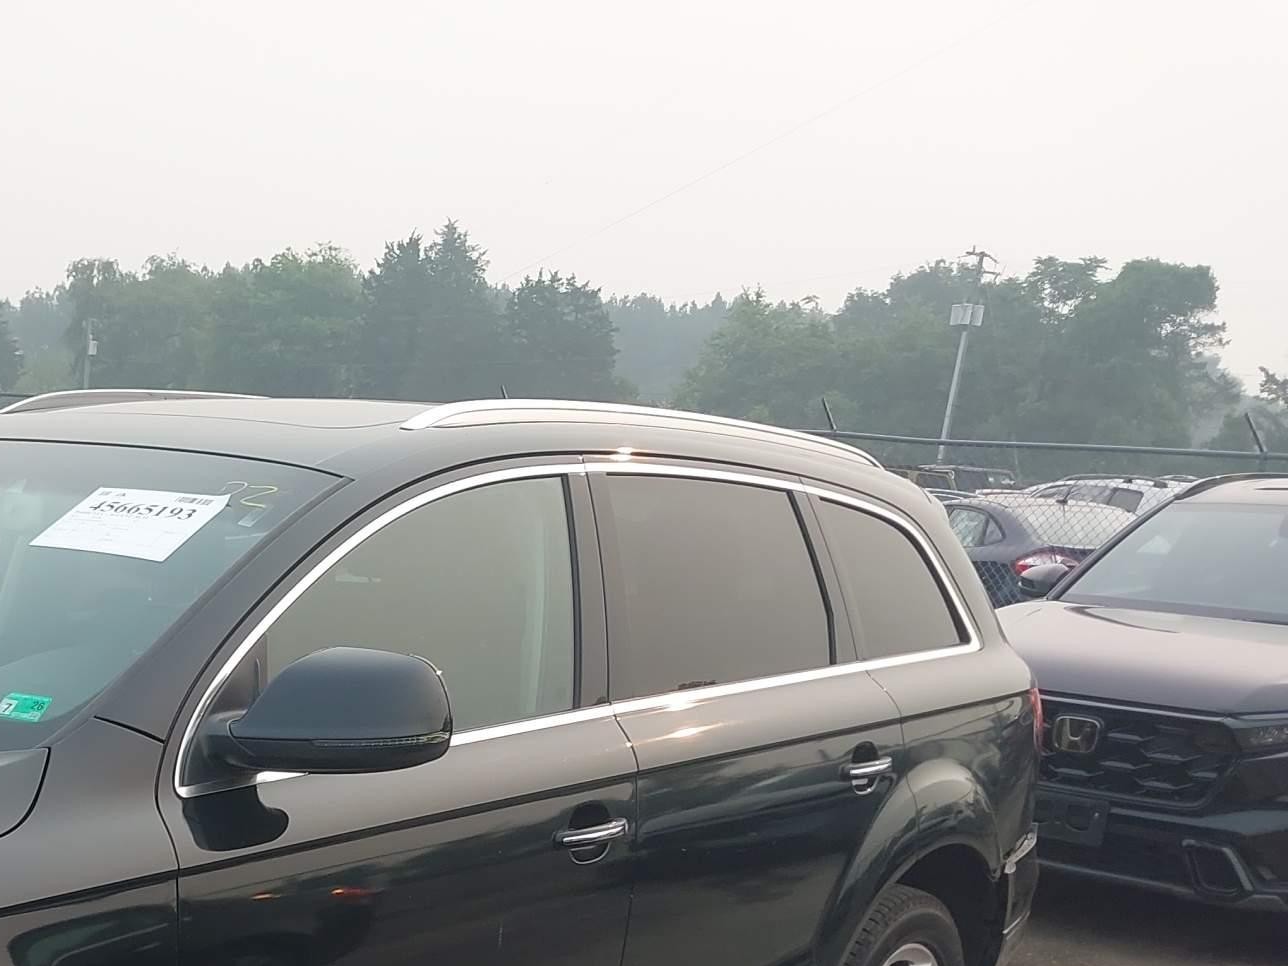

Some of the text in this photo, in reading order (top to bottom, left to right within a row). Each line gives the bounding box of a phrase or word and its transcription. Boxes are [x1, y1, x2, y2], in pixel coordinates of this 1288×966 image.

[89, 501, 198, 520] 45665193
[2, 701, 45, 713] 7 26
